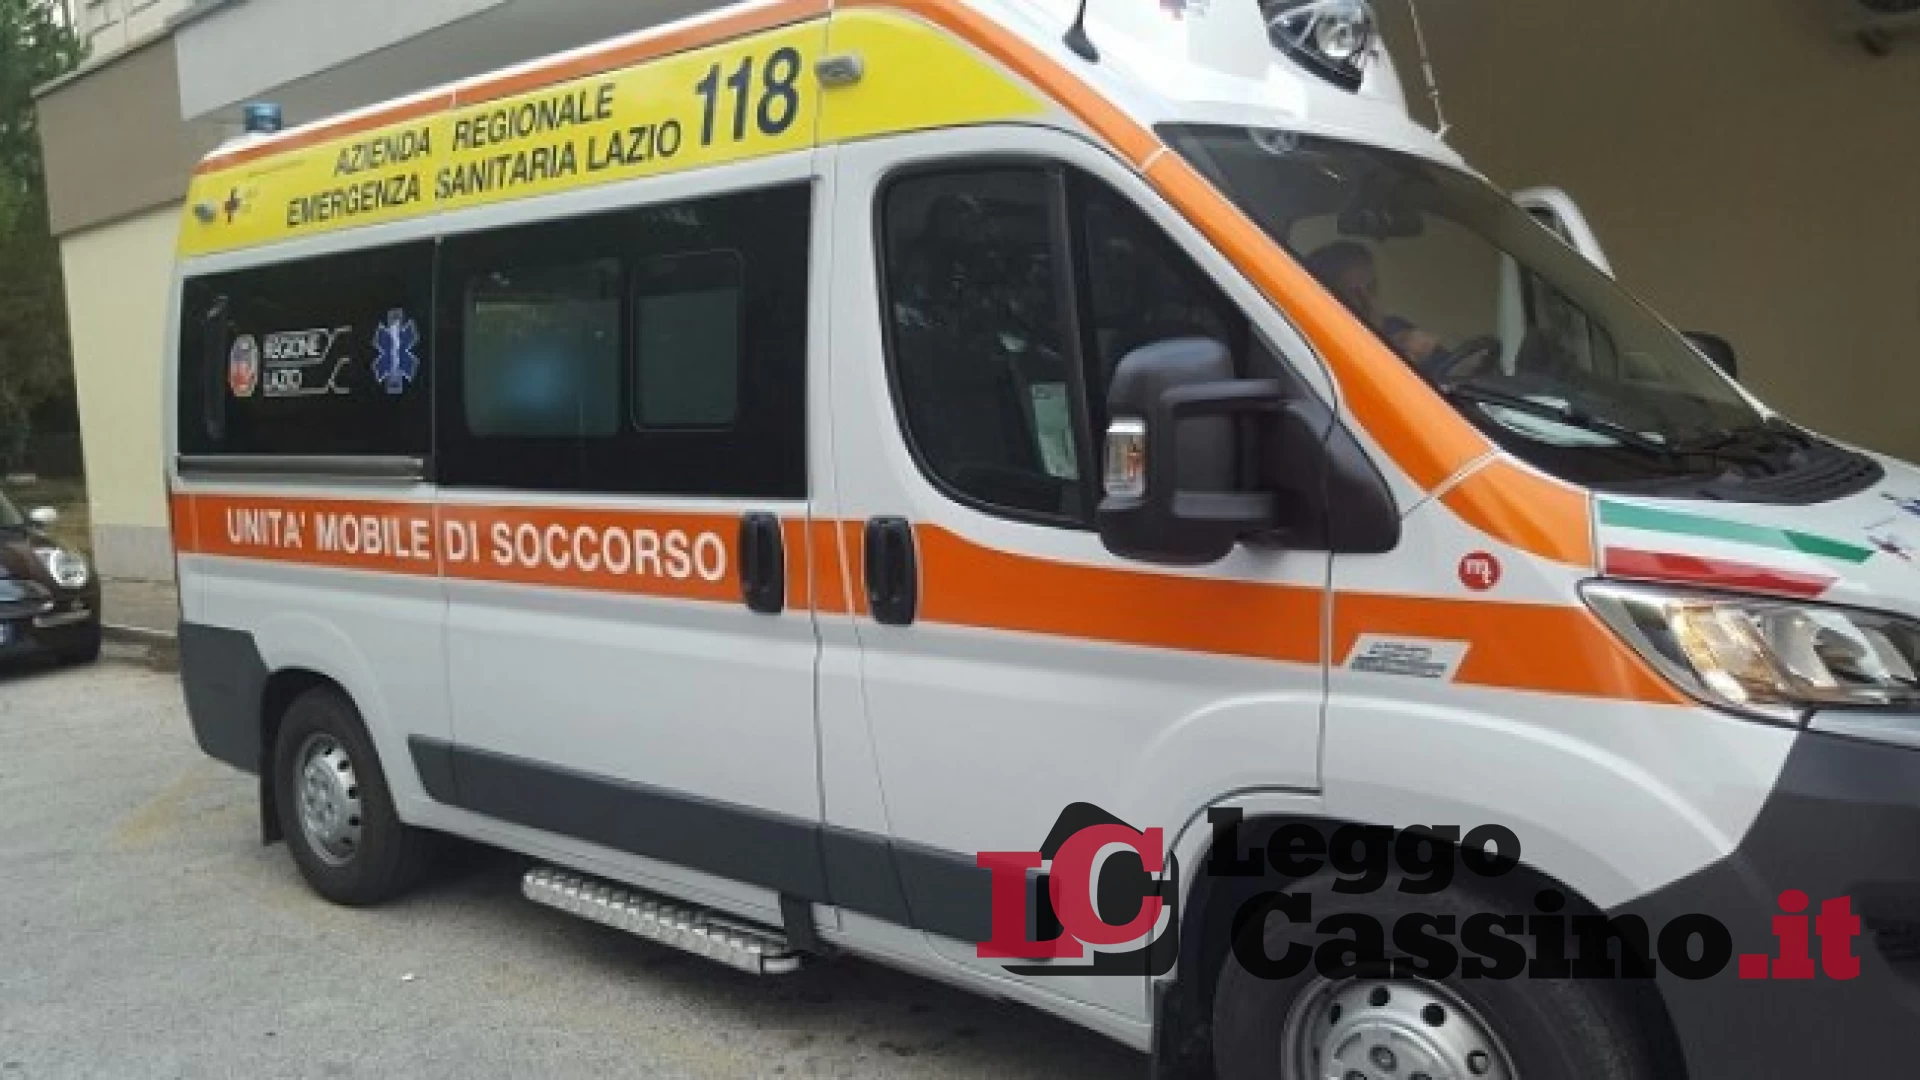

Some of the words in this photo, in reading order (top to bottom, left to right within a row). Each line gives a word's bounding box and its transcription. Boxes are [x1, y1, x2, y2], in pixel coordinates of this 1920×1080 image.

[334, 127, 432, 178] AZIENDA
[451, 82, 616, 154] REGIONALE
[695, 47, 801, 147] 118
[286, 179, 420, 228] EMERGENZA
[434, 149, 578, 200] SANITARIA
[586, 120, 681, 172] LAZIO
[226, 508, 305, 549] UNITA'
[315, 514, 432, 560] MOBILE
[445, 520, 480, 563] DI
[492, 522, 727, 581] SOCCORSO
